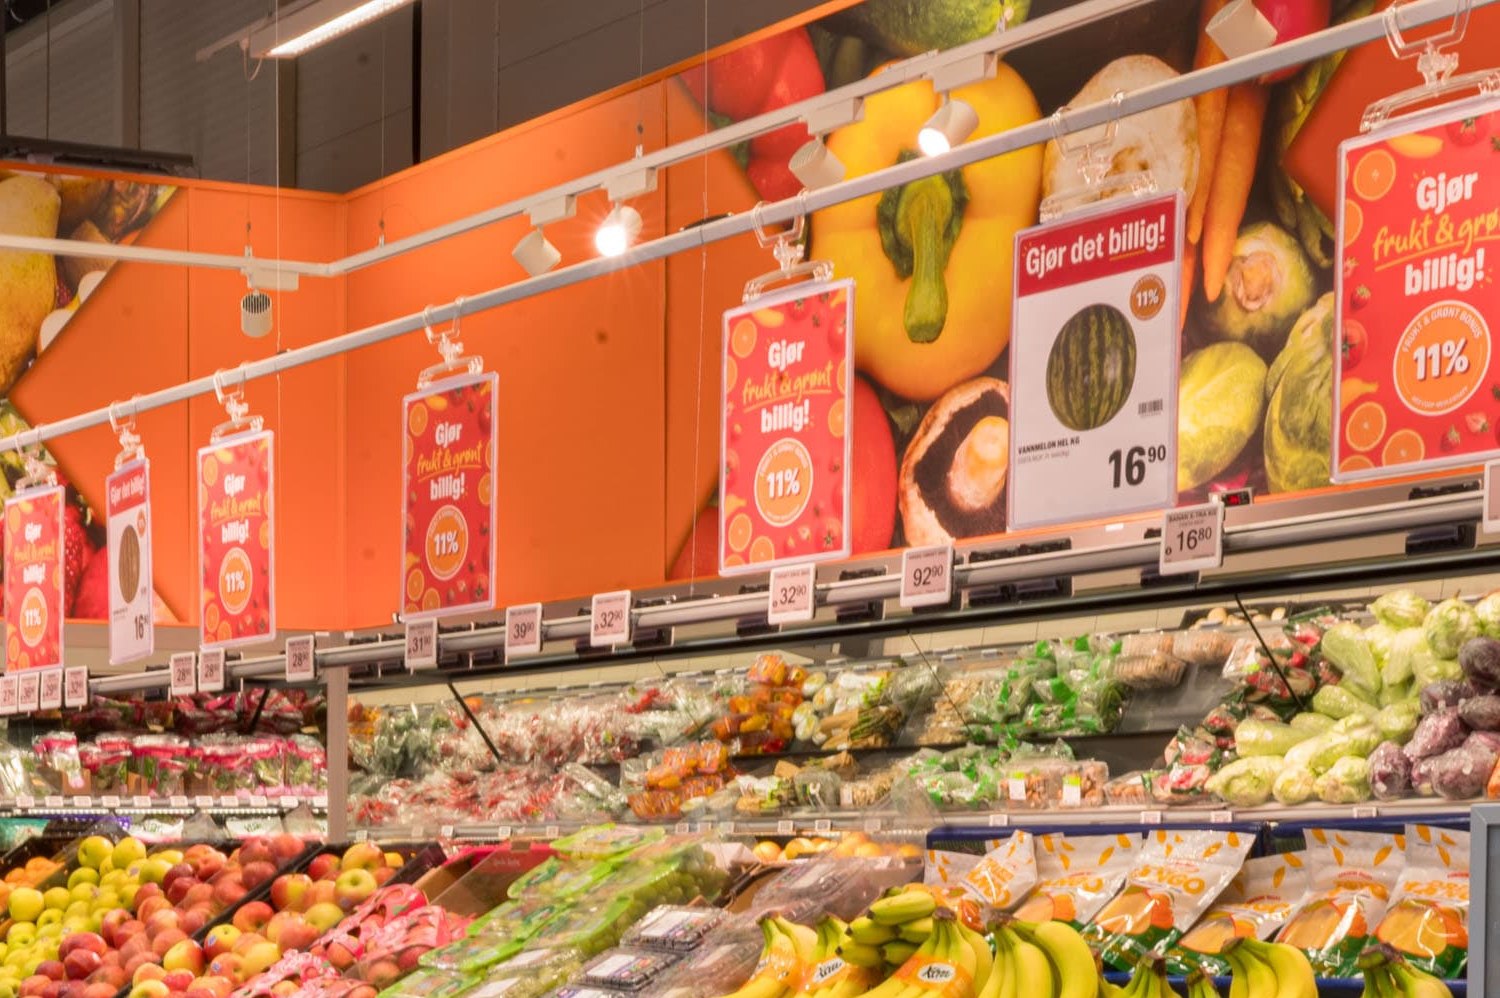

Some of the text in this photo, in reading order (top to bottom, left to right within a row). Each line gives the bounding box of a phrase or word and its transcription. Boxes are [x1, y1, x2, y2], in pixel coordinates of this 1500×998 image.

[1416, 172, 1478, 214] Gjør
[1026, 214, 1166, 279] Gjør det billig!
[1373, 208, 1500, 261] frukt & grø
[1404, 248, 1485, 296] billig!
[1136, 290, 1159, 308] 11%
[768, 340, 805, 371] Gjør
[1412, 337, 1469, 382] 11%
[742, 360, 833, 405] frukt & grønt
[761, 399, 810, 433] billig!
[435, 421, 462, 448] Gjør
[417, 449, 442, 476] frukt
[430, 472, 465, 500] billig!
[767, 467, 800, 498] 11%
[434, 530, 459, 556] 11%
[225, 570, 245, 592] 11%
[24, 608, 42, 628] 11%
